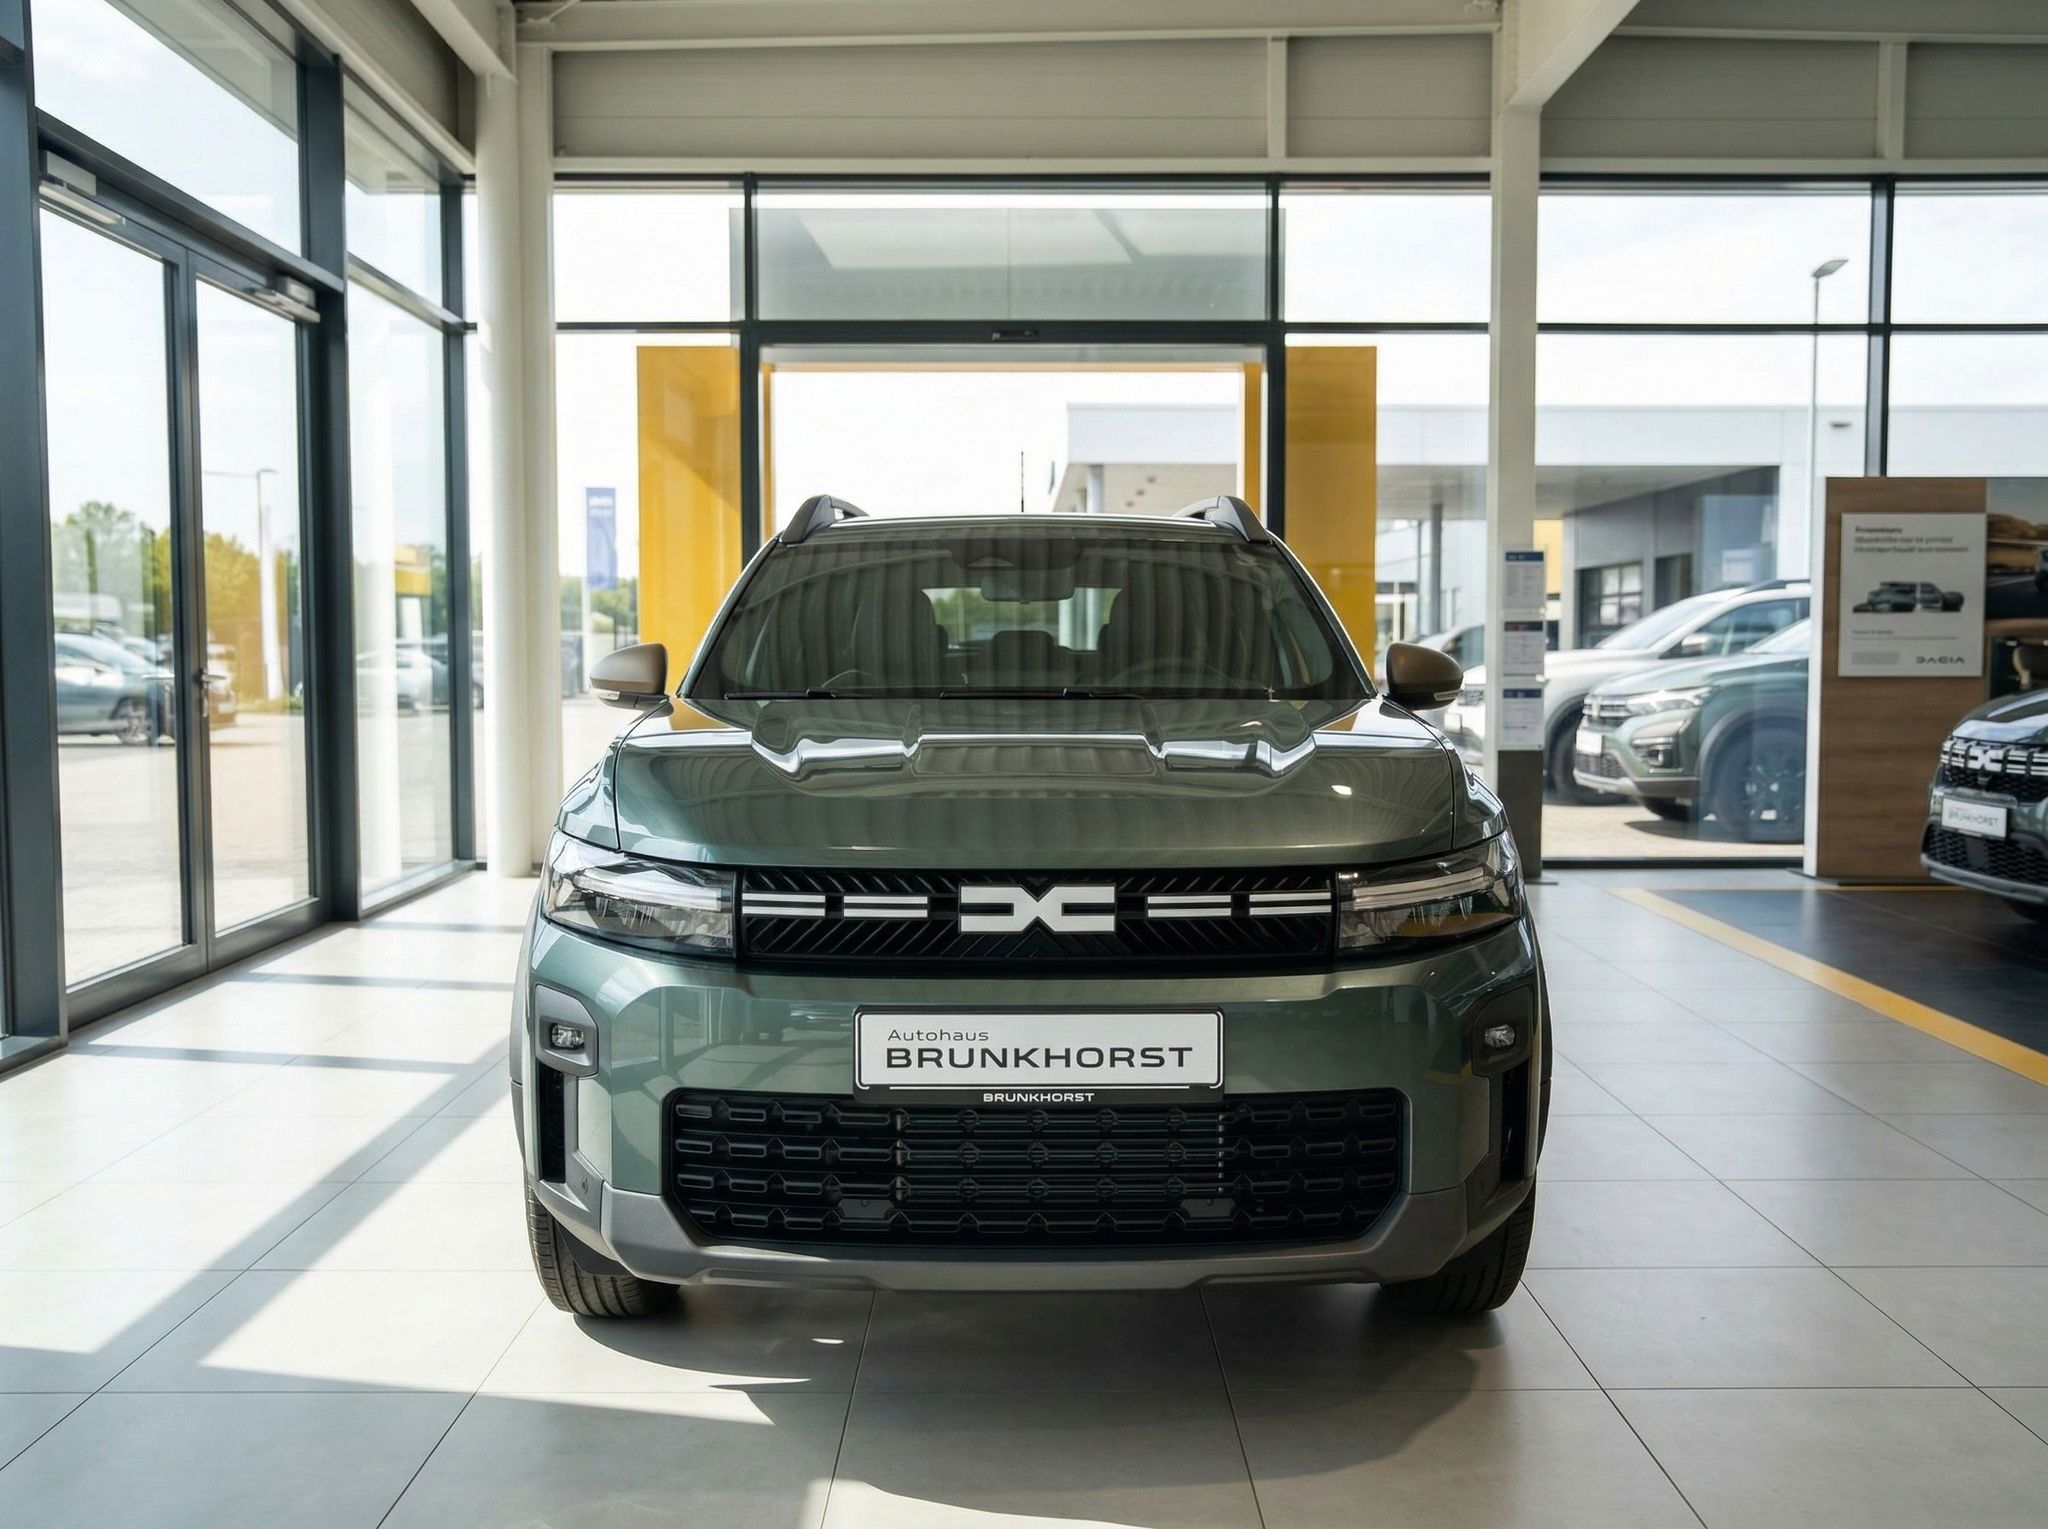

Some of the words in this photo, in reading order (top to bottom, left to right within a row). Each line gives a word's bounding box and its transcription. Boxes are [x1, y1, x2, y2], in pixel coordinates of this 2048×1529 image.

[1916, 656, 1965, 664] DACIA
[887, 1029, 989, 1041] Autohaus
[886, 1047, 1193, 1068] BRUNKHORST
[983, 1093, 1095, 1102] BRUNKHORST
